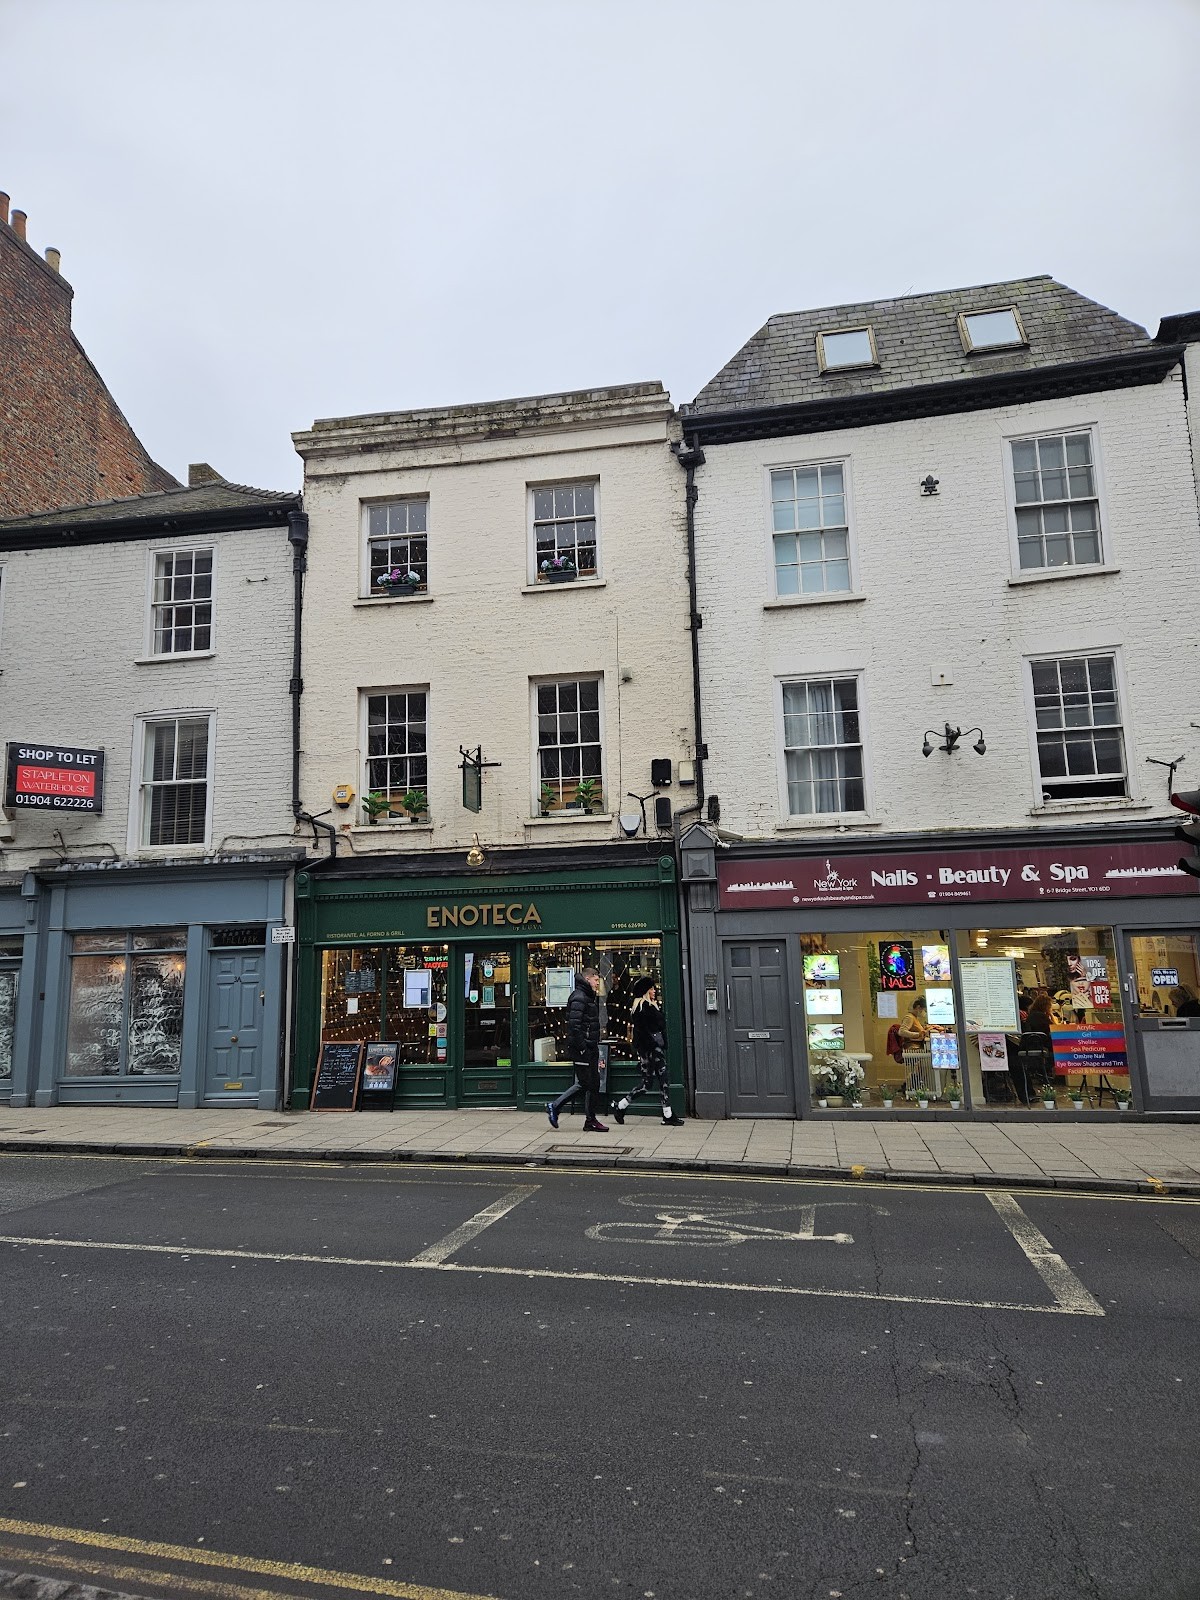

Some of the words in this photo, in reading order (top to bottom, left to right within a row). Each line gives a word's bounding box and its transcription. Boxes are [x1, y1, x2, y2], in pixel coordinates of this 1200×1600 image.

[18, 748, 54, 761] SHOP
[56, 752, 74, 763] TO
[76, 754, 97, 765] LET
[22, 769, 90, 783] STAPLETON
[22, 781, 89, 793] WATERHOUSE
[15, 794, 51, 806] 01904
[53, 796, 94, 808] 622226
[871, 869, 918, 887] Nails
[938, 866, 1011, 886] Beauty
[1021, 864, 1041, 882] &
[1050, 863, 1089, 883] Spa
[813, 879, 836, 888] New
[837, 878, 857, 887] York
[1055, 886, 1072, 894] Bridge
[427, 903, 542, 927] ENOTECA
[1086, 959, 1102, 968] 10%
[1092, 967, 1106, 977] OFF
[1153, 975, 1178, 985] OPEN
[1092, 985, 1110, 995] 10%
[1094, 995, 1110, 1004] OFF
[1089, 1068, 1115, 1076] Massage
